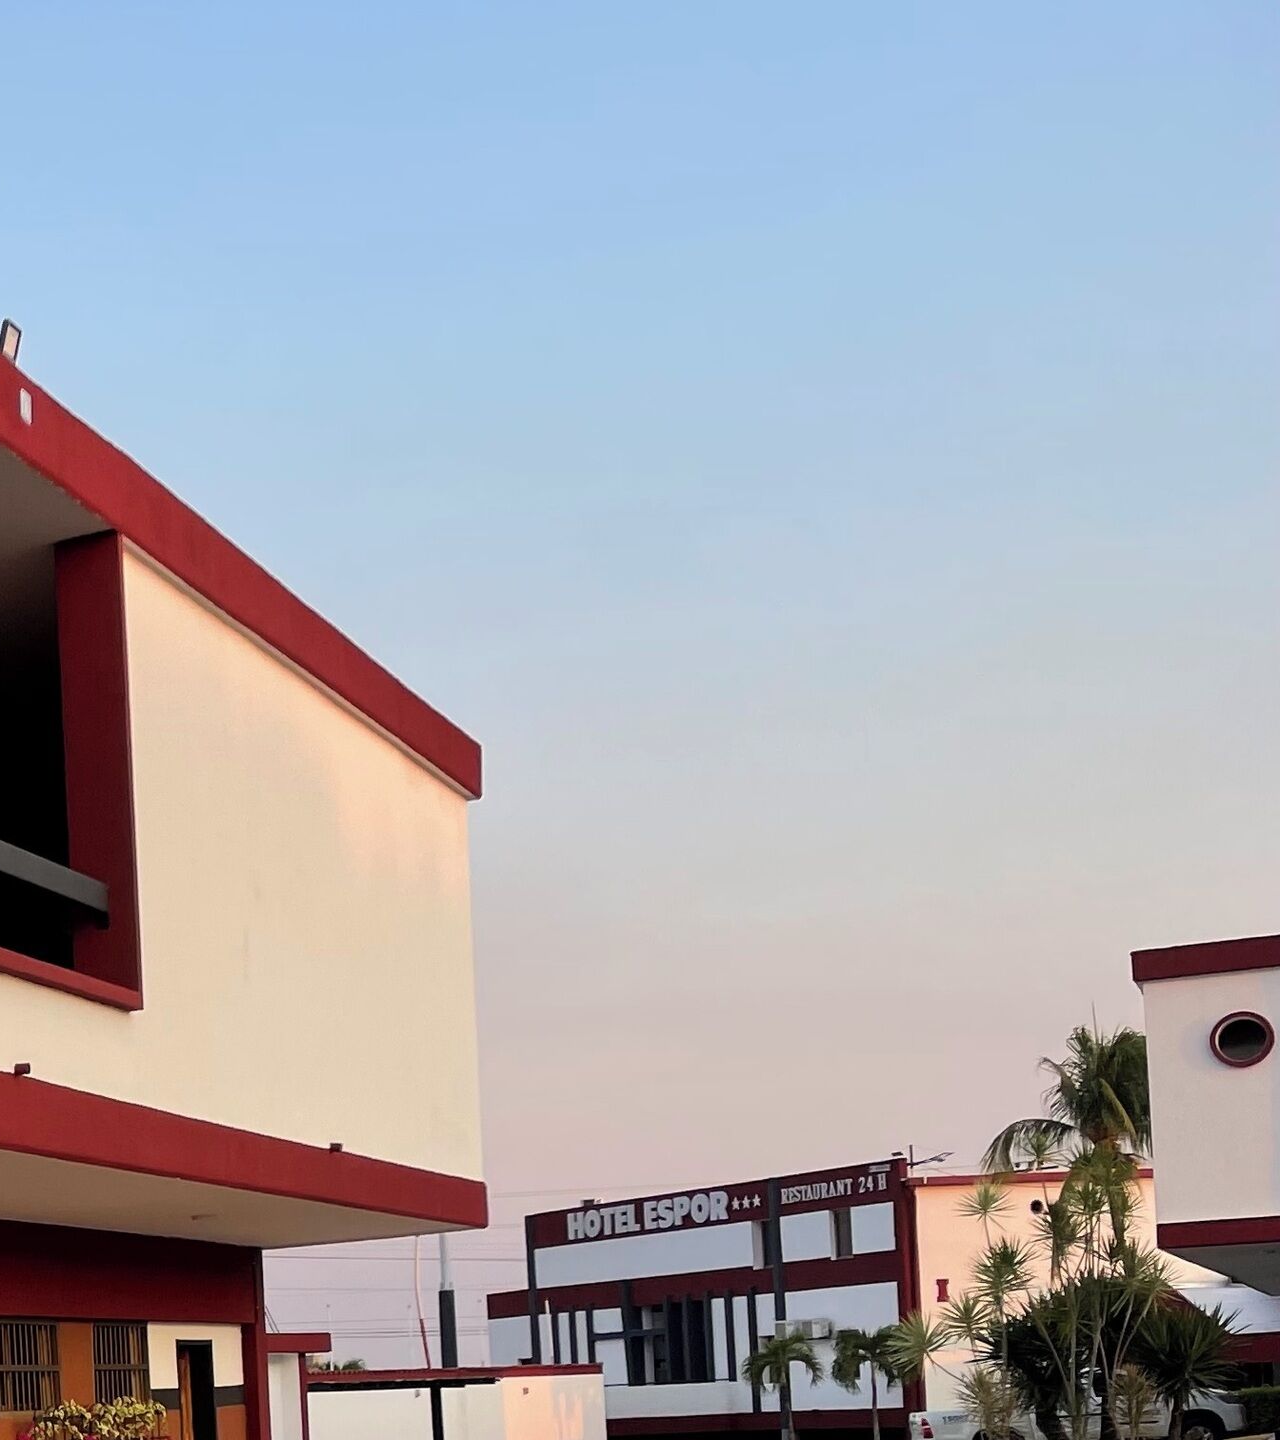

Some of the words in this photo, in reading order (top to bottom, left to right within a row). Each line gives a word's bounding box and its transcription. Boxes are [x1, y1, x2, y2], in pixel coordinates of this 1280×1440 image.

[781, 1178, 852, 1205] RESTAURANT
[858, 1177, 874, 1194] 24
[566, 1204, 641, 1241] HOTEL
[643, 1190, 729, 1230] ESPOR
